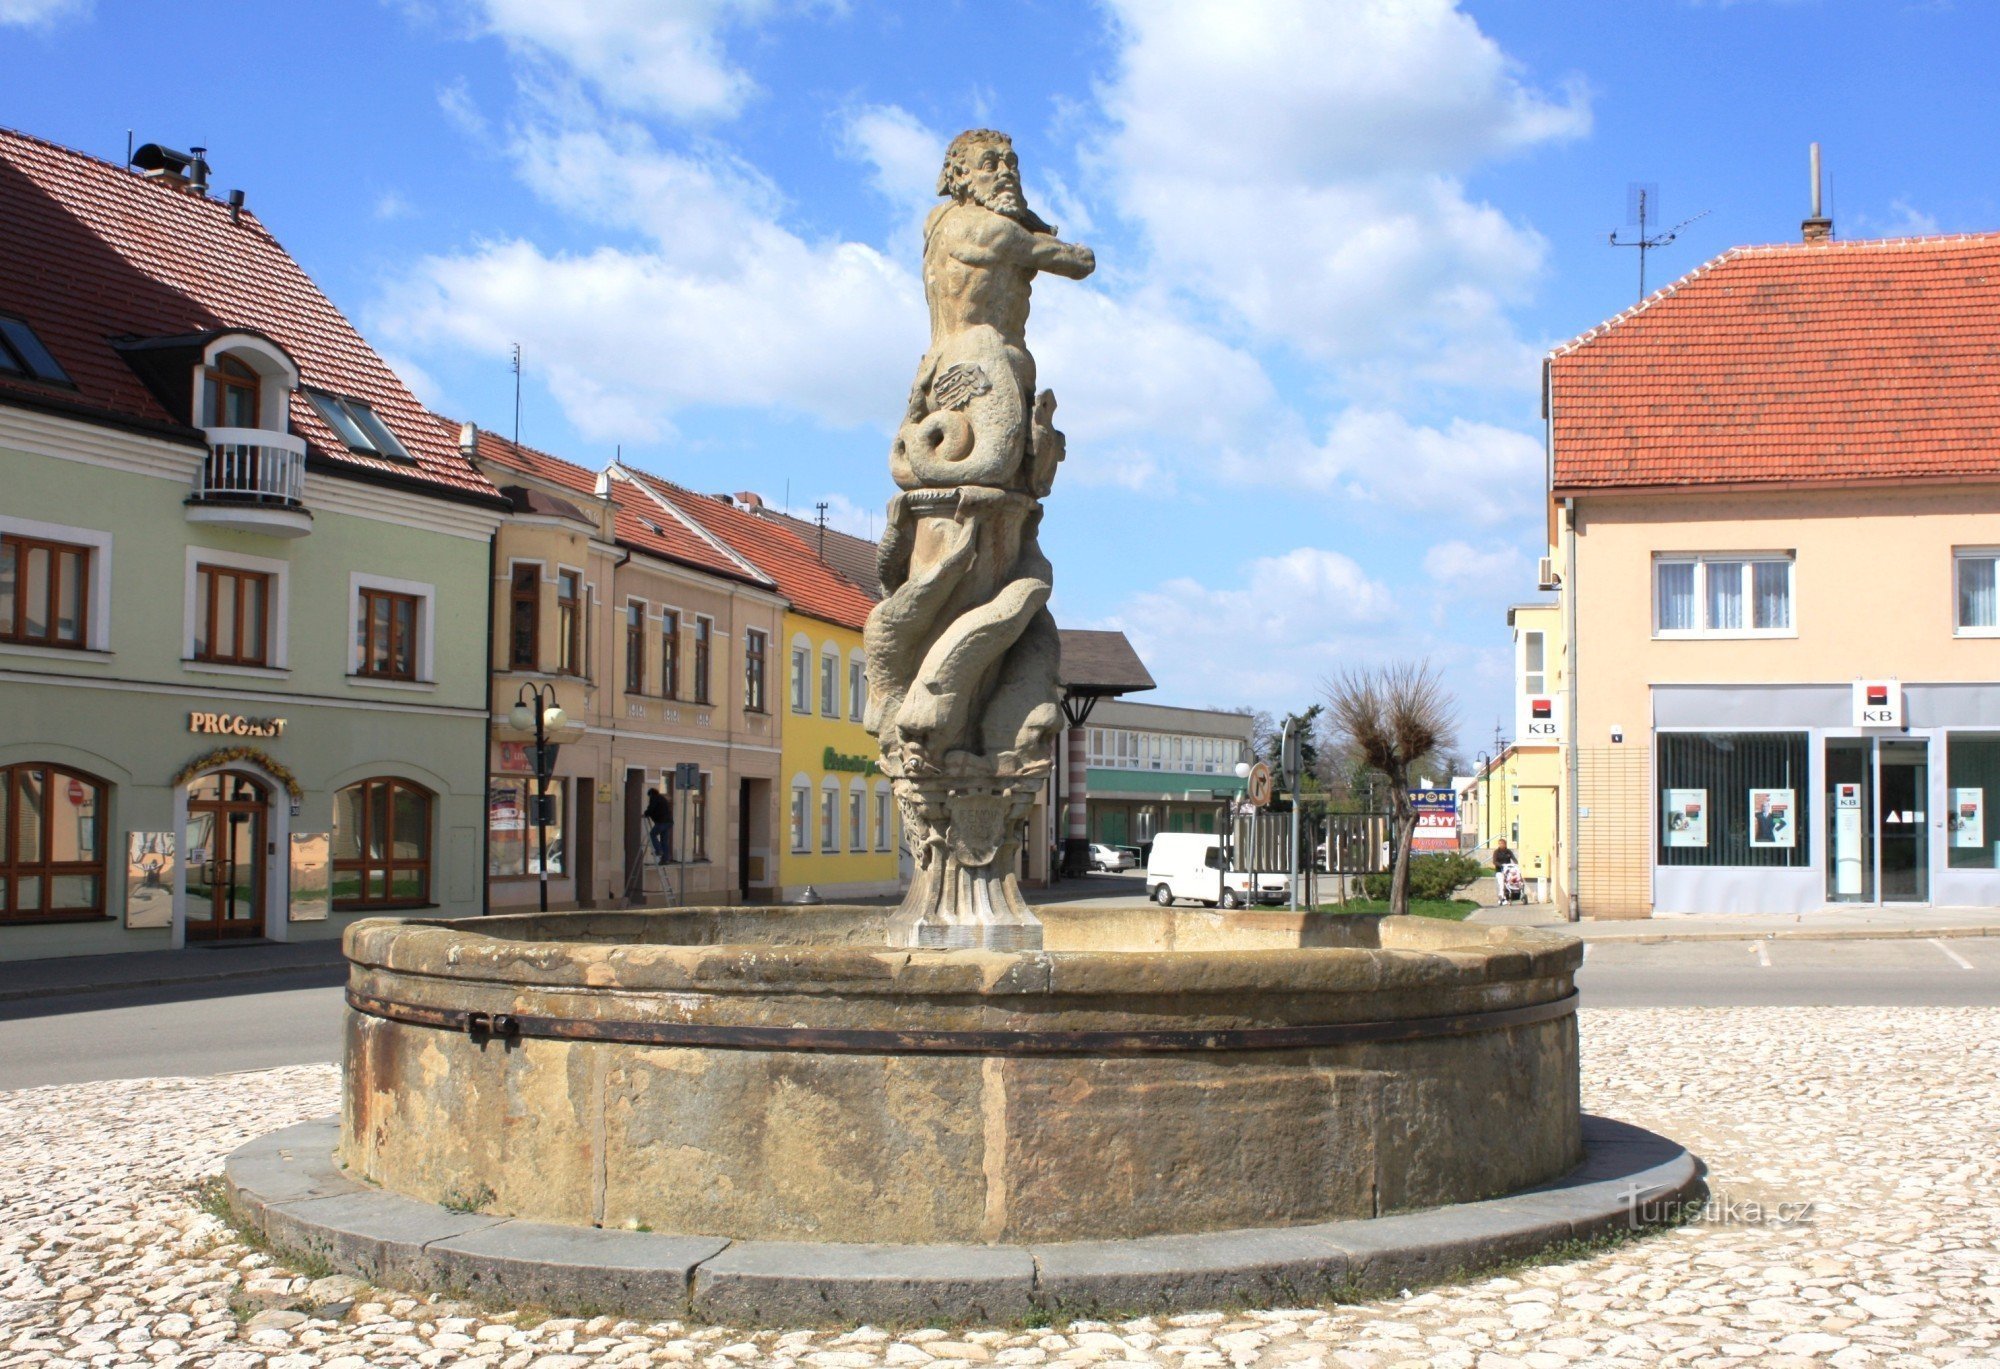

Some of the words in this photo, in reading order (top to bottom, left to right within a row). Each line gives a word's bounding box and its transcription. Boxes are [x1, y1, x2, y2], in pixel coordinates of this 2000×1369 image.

[1863, 710, 1893, 722] KB
[1528, 723, 1557, 735] KB
[1409, 791, 1455, 803] SPORT
[1840, 799, 1857, 807] KB
[1416, 814, 1455, 827] DĚVY
